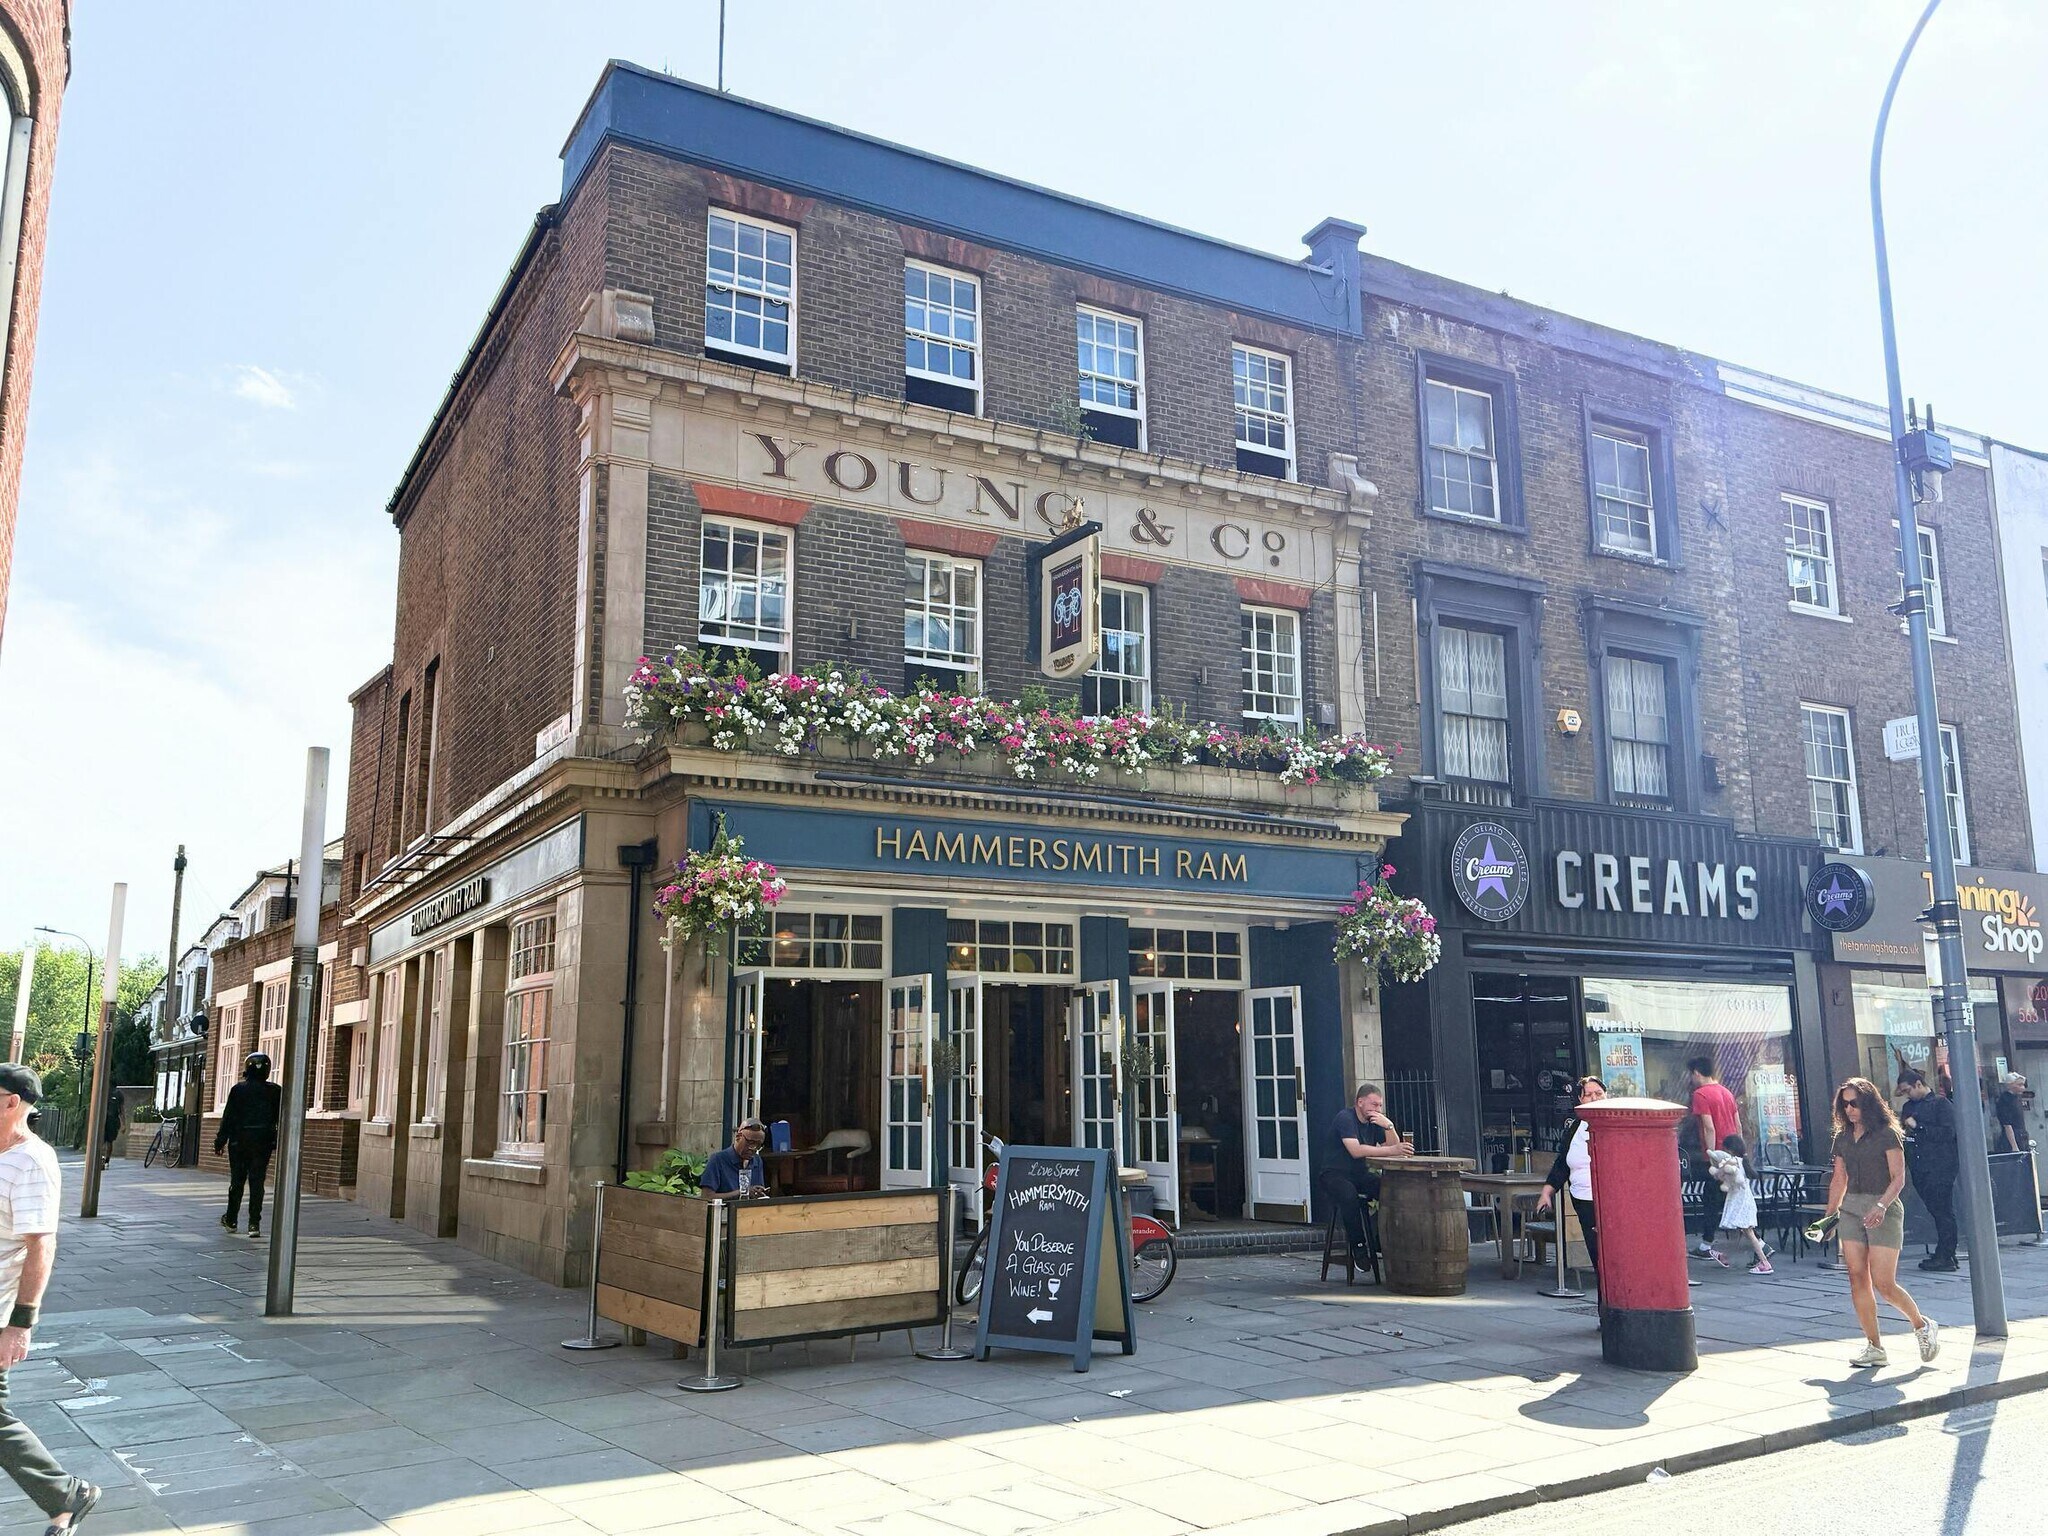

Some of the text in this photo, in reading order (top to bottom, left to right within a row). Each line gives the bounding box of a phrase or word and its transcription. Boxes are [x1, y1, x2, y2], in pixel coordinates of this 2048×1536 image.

[1130, 507, 1175, 547] &
[877, 827, 1249, 883] HAMMERSMITH RAM
[1466, 857, 1513, 881] Creams
[1556, 850, 1759, 921] CREAMS
[1817, 888, 1853, 905] Creams
[1921, 871, 2017, 924] Tnning
[411, 877, 484, 937] HAMMERSMITH RAM
[1840, 938, 1919, 956] thetanningshop.co.uk
[1981, 914, 2044, 964] Shop
[2027, 984, 2048, 1001] 020
[105, 1023, 111, 1031] 2
[1606, 1055, 1638, 1067] SLAYERS
[1028, 1162, 1081, 1179] Live Sport
[1009, 1184, 1090, 1212] HAMMERSMITH
[1005, 1253, 1018, 1274] A
[1058, 1263, 1075, 1277] OF
